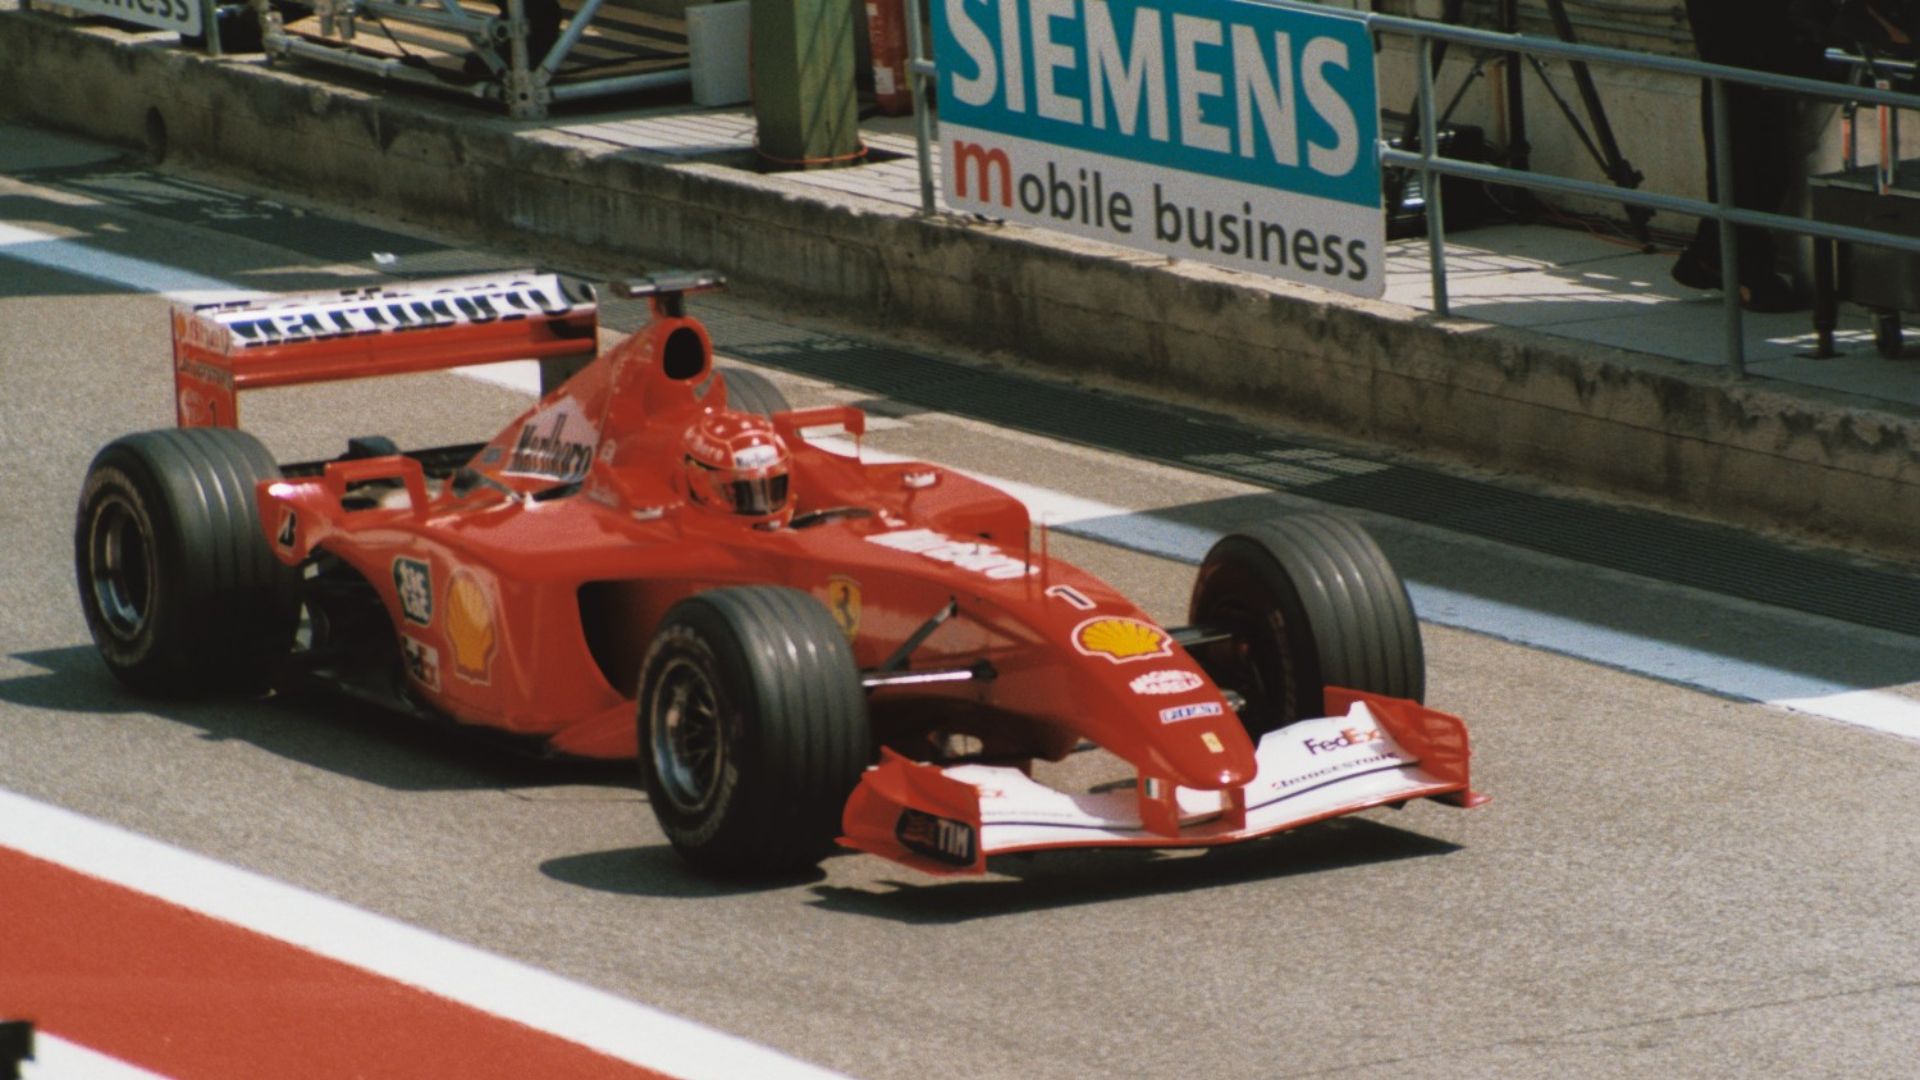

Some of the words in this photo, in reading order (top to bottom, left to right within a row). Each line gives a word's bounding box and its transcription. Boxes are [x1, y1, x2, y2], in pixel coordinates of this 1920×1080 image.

[944, 0, 1360, 177] SIEMENS
[953, 139, 1133, 233] mobile
[1153, 182, 1369, 282] business
[1045, 584, 1097, 611] 1
[937, 818, 970, 858] TIM
